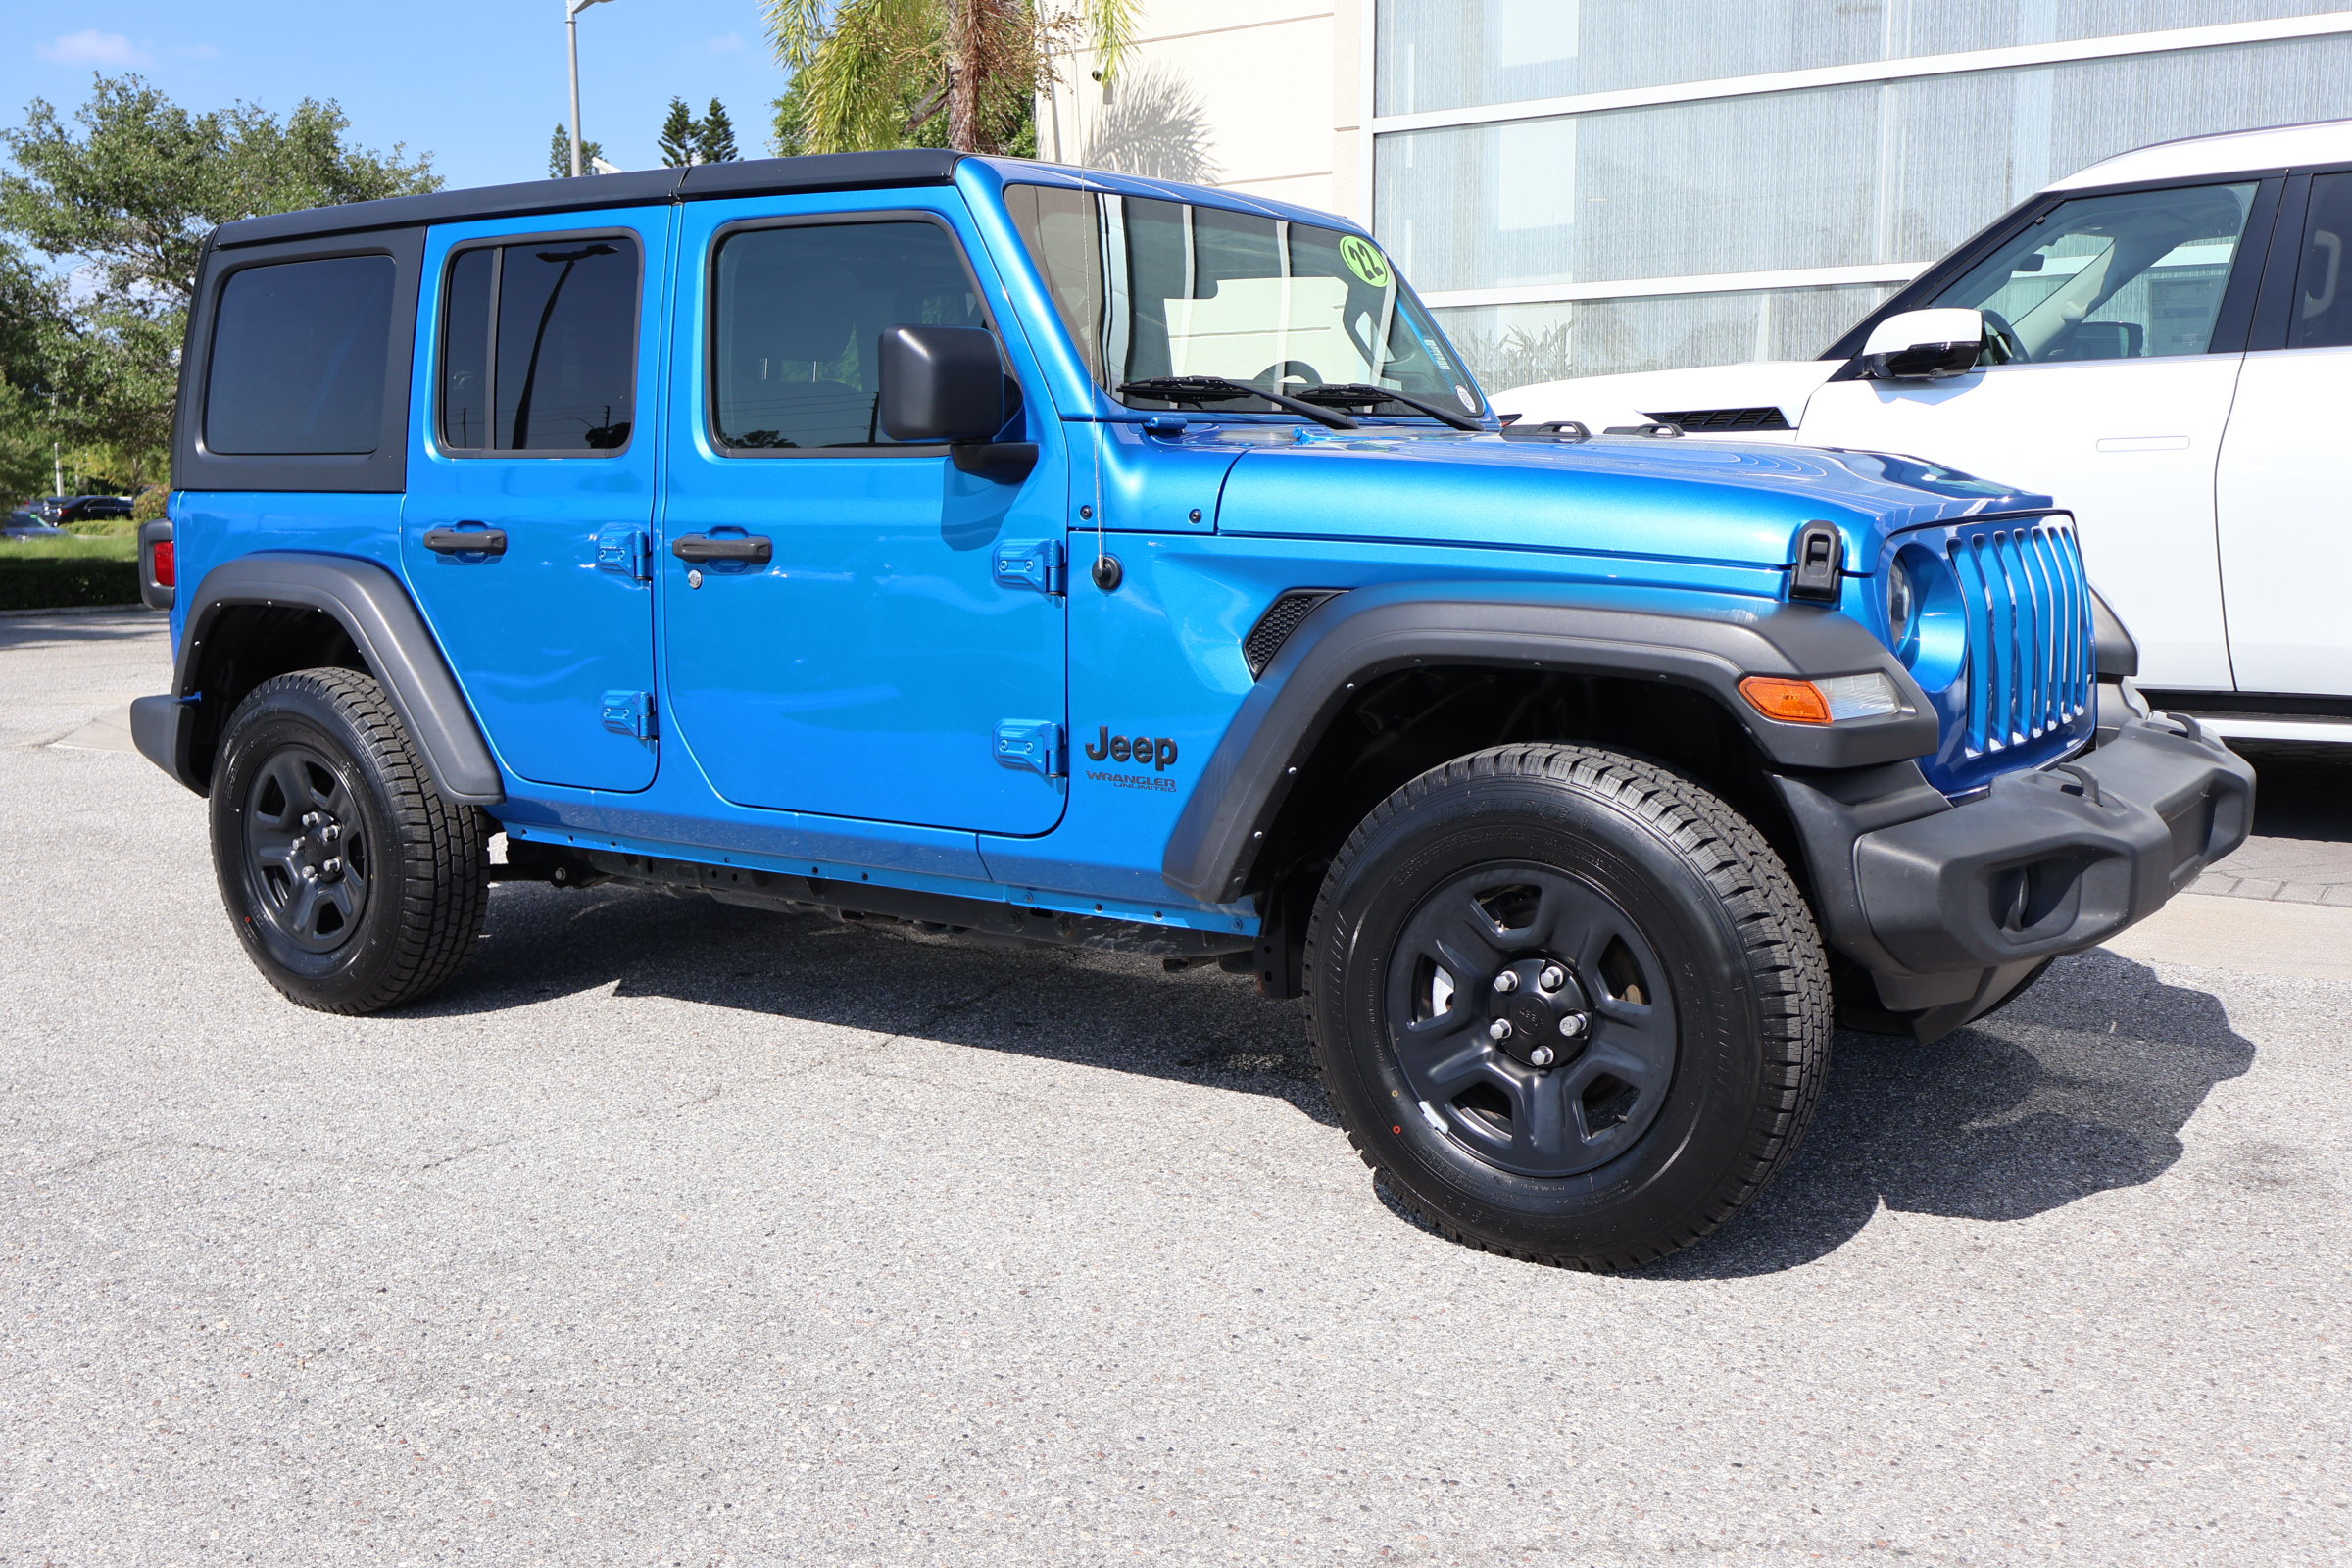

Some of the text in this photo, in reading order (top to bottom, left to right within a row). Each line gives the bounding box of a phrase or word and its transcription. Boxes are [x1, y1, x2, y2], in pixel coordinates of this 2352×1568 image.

[1348, 241, 1384, 280] 22
[1085, 725, 1178, 771] Jeep
[1085, 769, 1176, 788] WRANGLER
[1113, 782, 1177, 793] UNLIMITED
